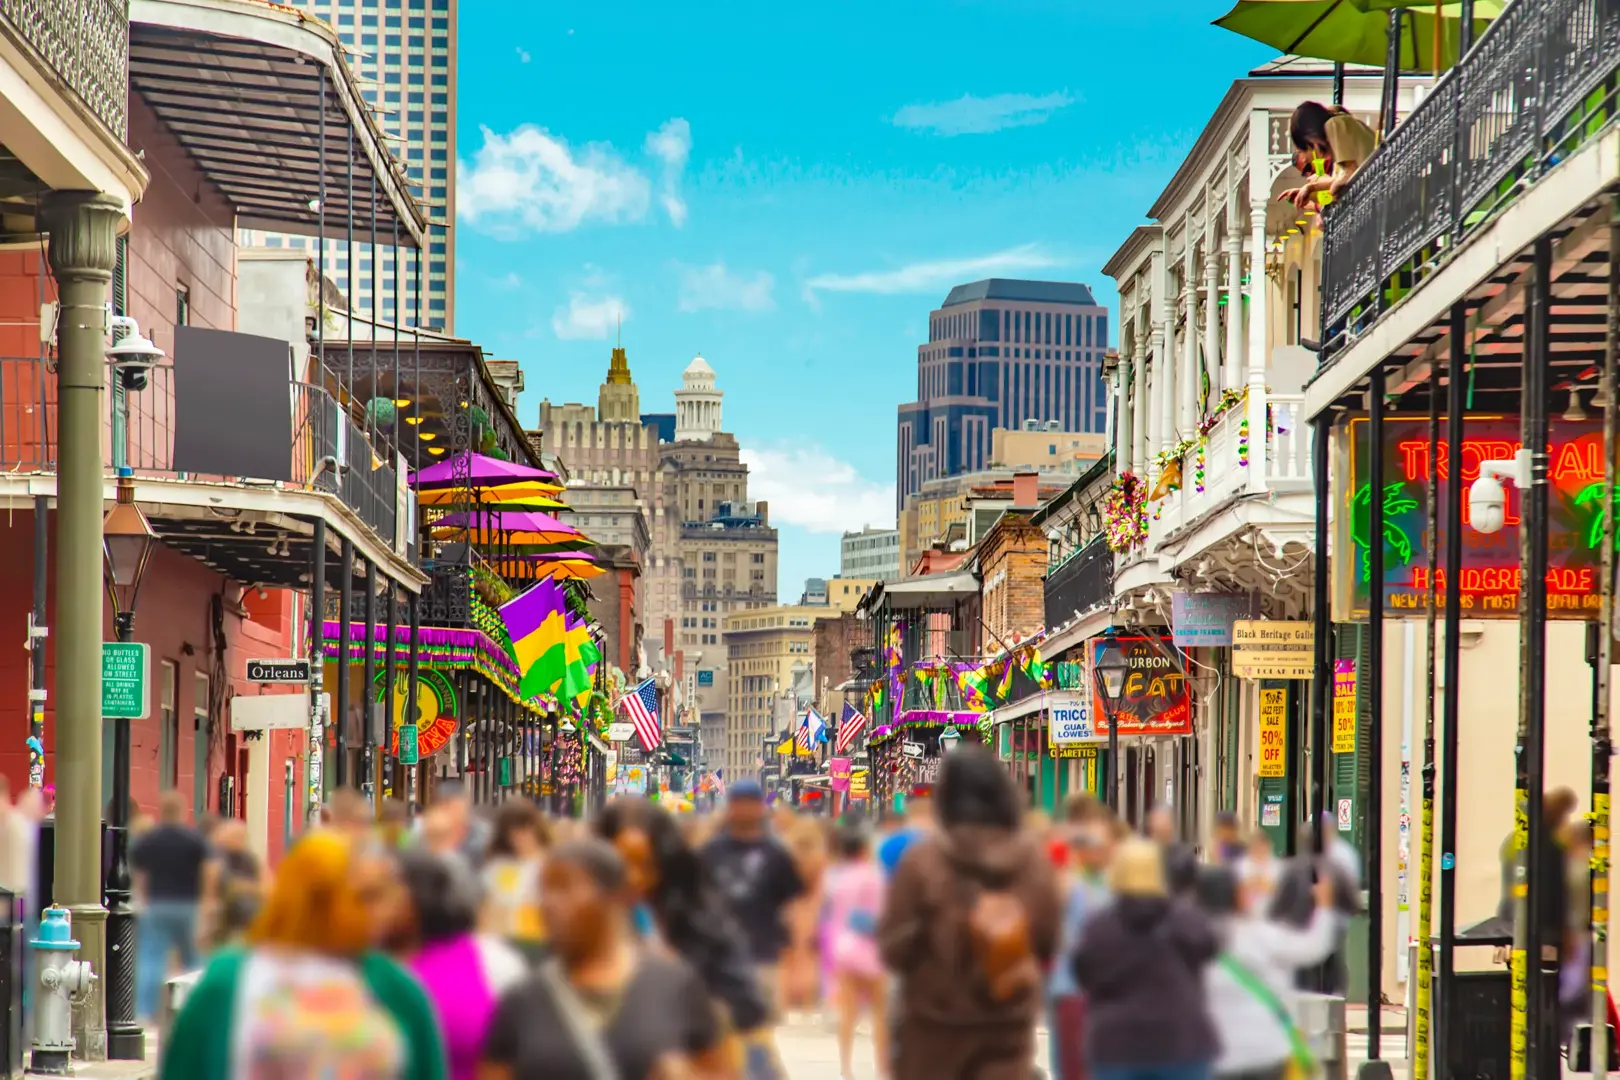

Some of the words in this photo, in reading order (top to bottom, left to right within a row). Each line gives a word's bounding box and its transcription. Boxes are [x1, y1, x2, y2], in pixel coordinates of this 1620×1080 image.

[1390, 593, 1418, 608] NEW
[1483, 594, 1517, 609] MOST
[1236, 629, 1256, 638] Black
[1260, 628, 1291, 642] Heritage
[1295, 630, 1314, 639] Galle
[1129, 657, 1170, 668] URBON
[252, 666, 304, 679] Orleans
[1335, 683, 1356, 696] SALE
[1053, 709, 1087, 721] TRICO
[1163, 705, 1186, 720] CLUB
[1262, 706, 1272, 715] JAZZ
[1273, 705, 1284, 714] FEST
[1266, 716, 1279, 725] SALE
[1338, 718, 1354, 731] 50%
[1262, 731, 1283, 745] 50%
[1050, 748, 1096, 758] CGARETTES
[1264, 748, 1279, 761] OFF
